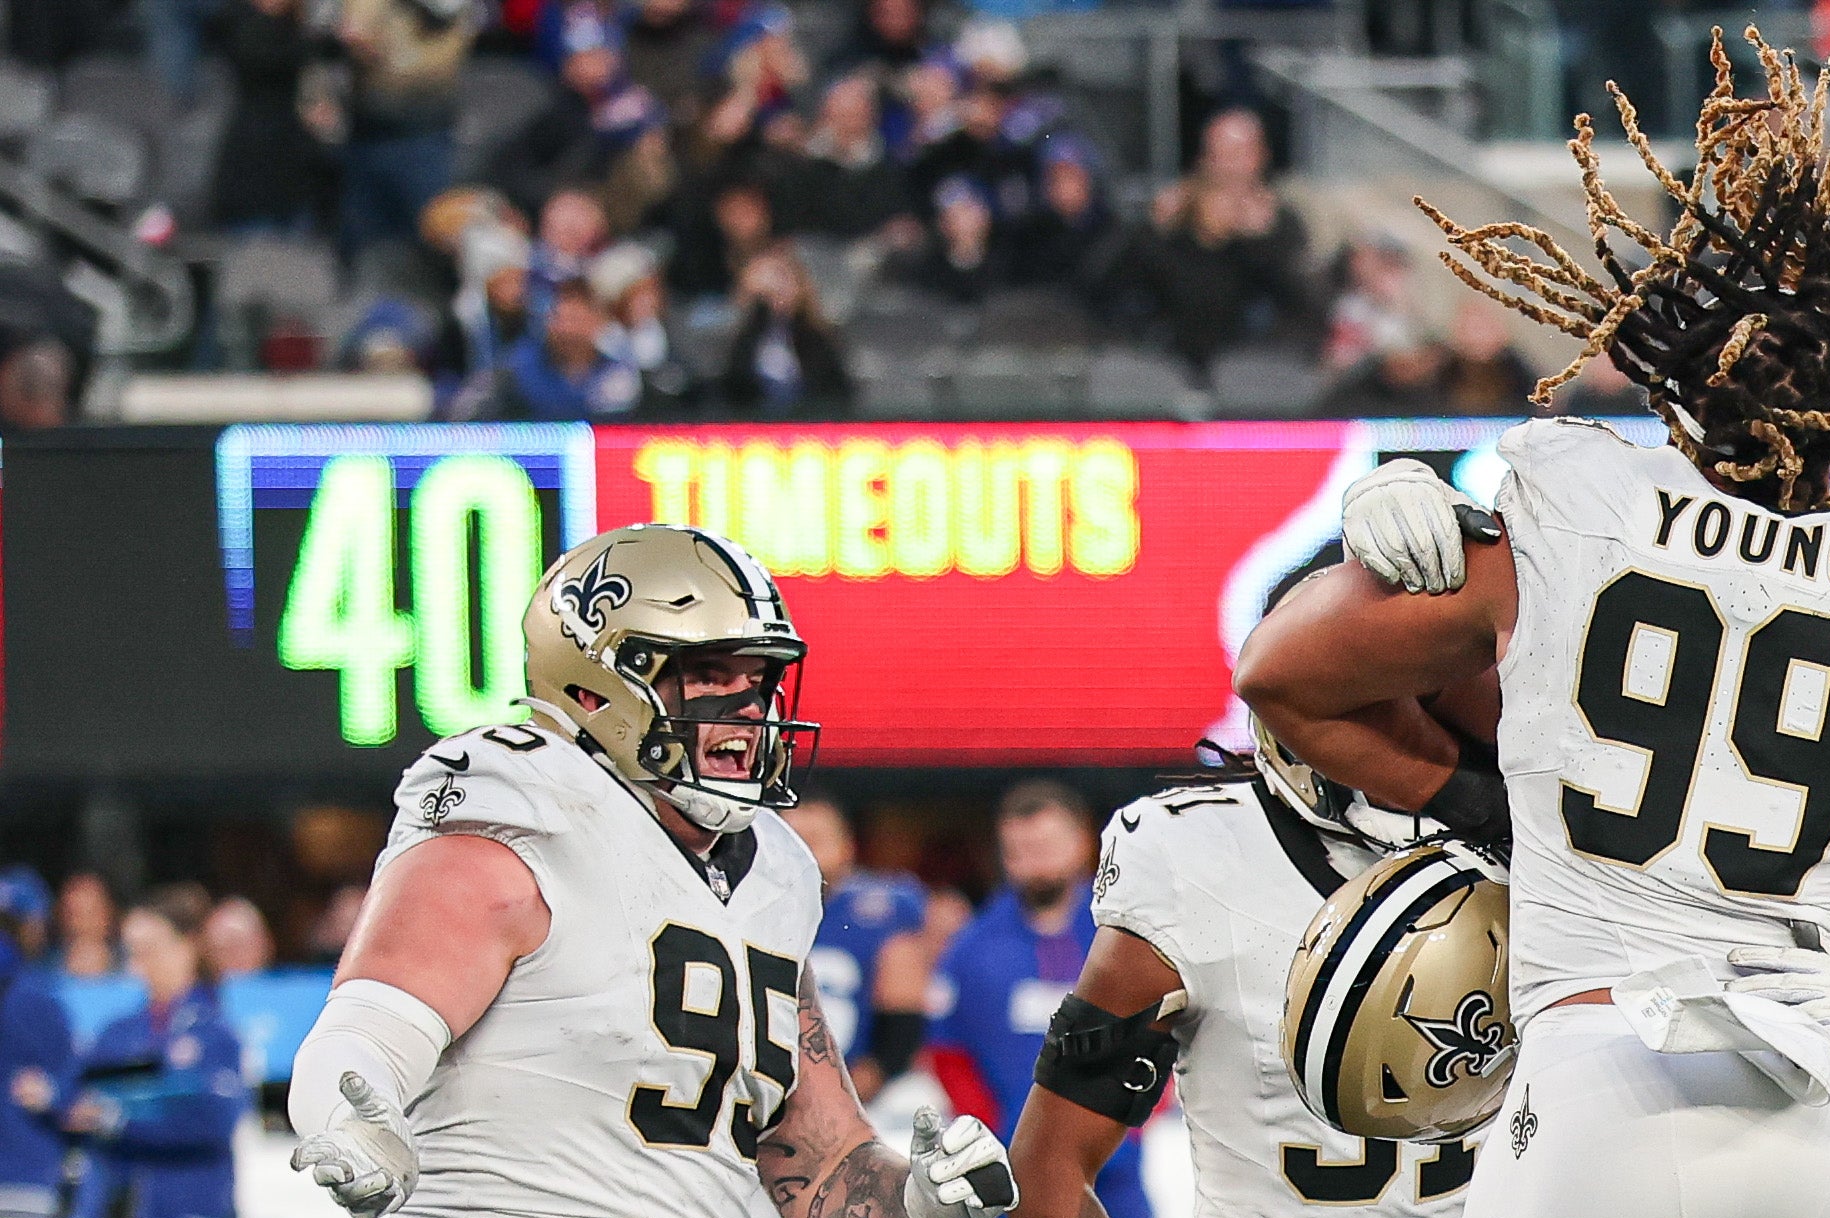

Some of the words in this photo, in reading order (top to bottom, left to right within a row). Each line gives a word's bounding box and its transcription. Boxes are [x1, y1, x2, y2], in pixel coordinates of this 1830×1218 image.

[277, 453, 544, 747] 40
[634, 436, 1141, 581] TIMEOUTS
[628, 919, 800, 1165] 95
